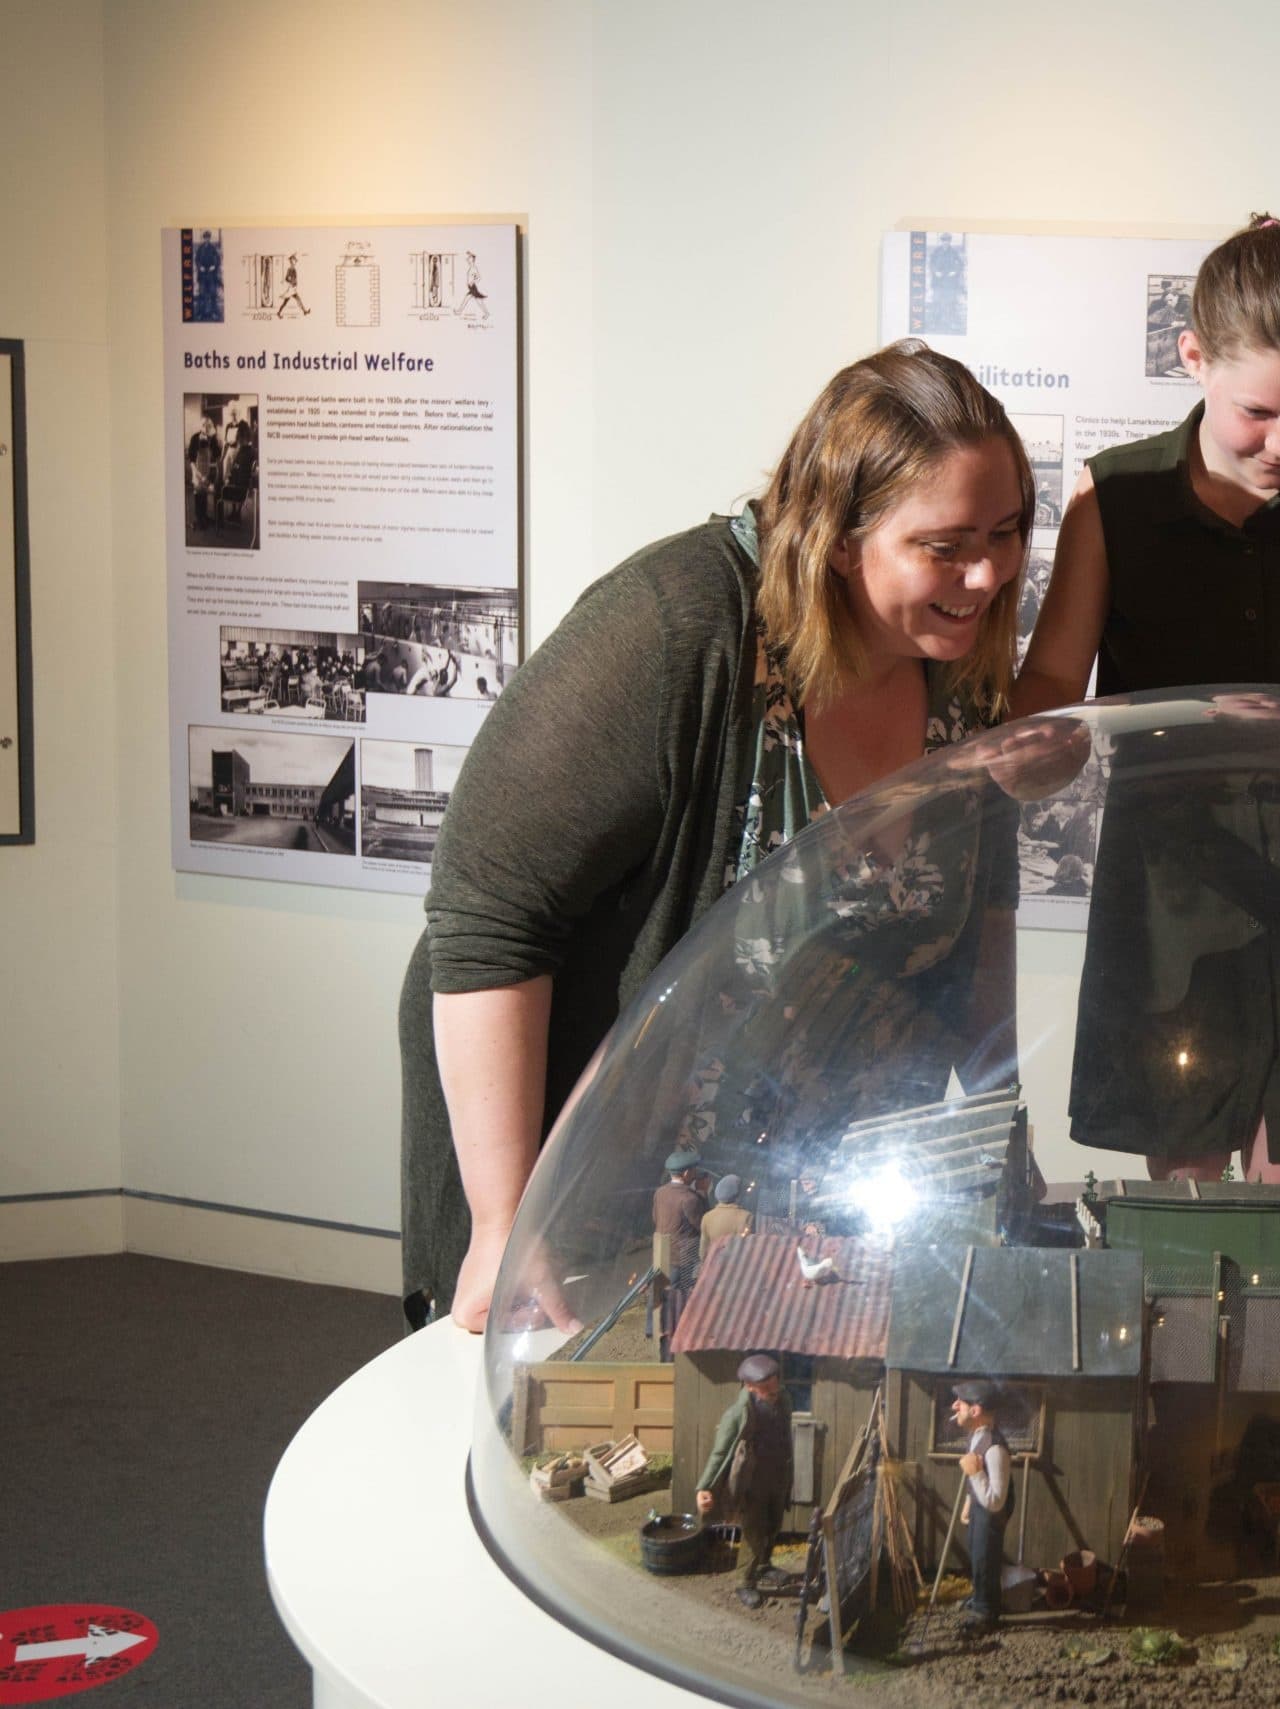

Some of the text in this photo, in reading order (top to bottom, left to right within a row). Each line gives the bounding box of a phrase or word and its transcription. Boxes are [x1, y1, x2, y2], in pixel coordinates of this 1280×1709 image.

[911, 238, 924, 330] WELFARE
[184, 350, 434, 372] Baths and Industrial Welfare
[966, 365, 1070, 388] ilitation
[1075, 442, 1090, 450] War
